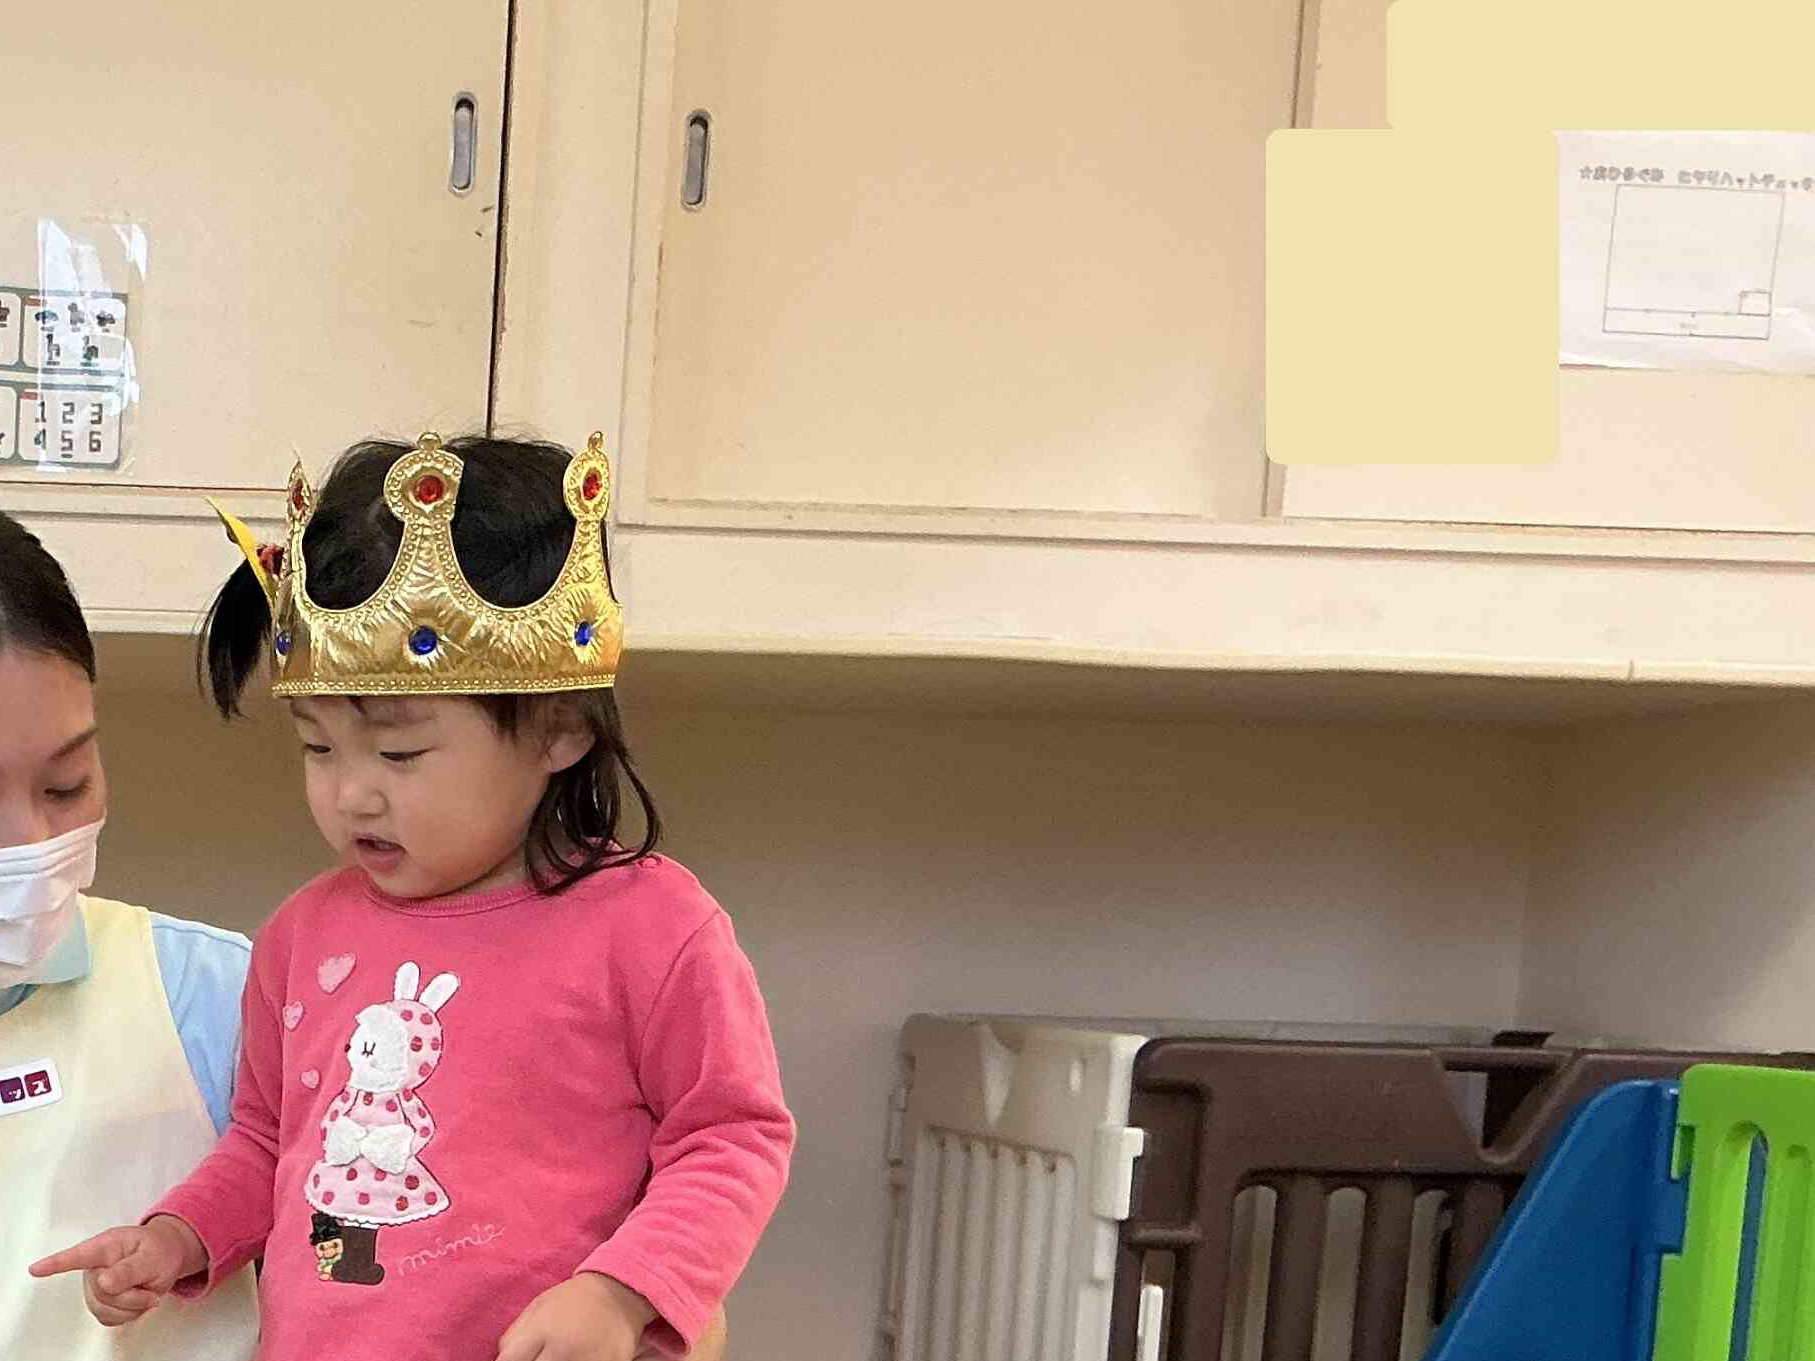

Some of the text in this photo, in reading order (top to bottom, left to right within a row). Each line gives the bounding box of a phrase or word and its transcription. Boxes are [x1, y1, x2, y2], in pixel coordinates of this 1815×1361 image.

[62, 402, 74, 424] 2
[90, 403, 103, 425] 3
[61, 430, 73, 451] 5
[89, 431, 102, 453] 6
